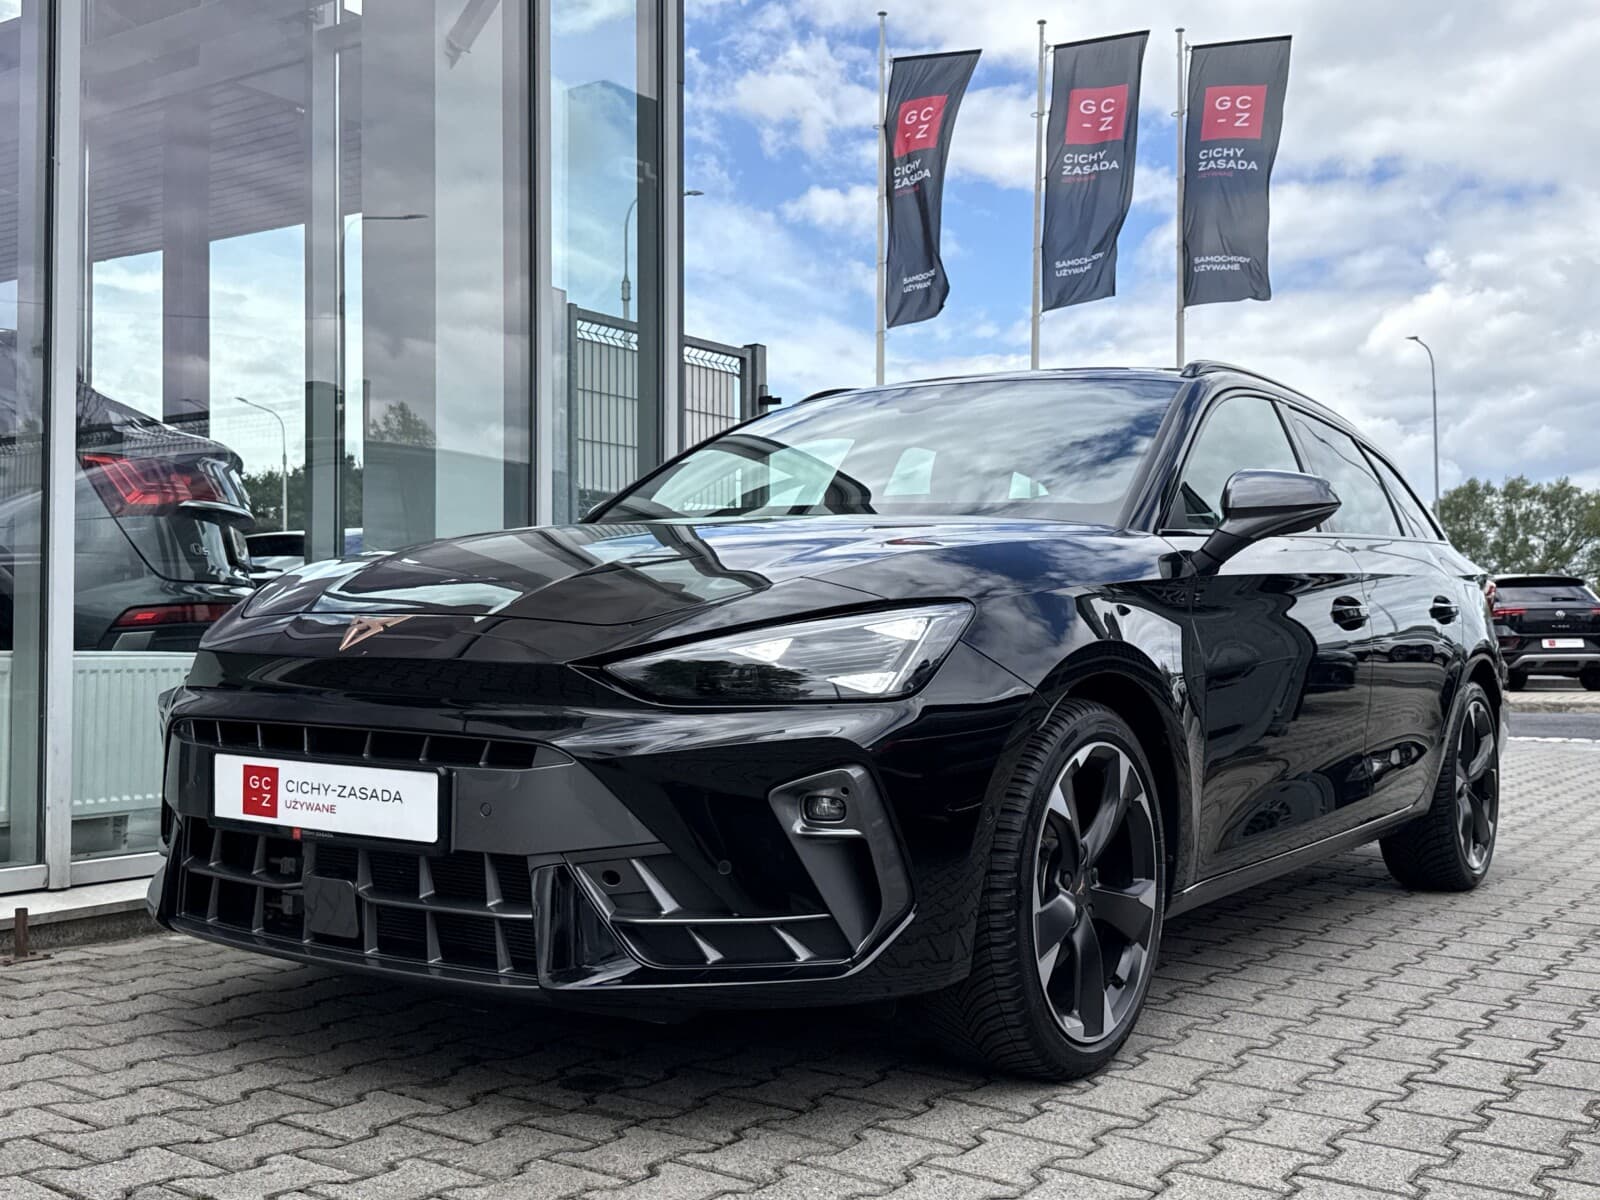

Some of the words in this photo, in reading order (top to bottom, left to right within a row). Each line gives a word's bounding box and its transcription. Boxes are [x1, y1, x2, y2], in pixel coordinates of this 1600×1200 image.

[1080, 98, 1115, 114] GC
[1215, 95, 1252, 110] GC
[905, 107, 934, 125] GC
[1063, 150, 1107, 164] CICHY
[1199, 147, 1245, 159] CICHY
[1062, 160, 1119, 175] ZASADA
[1198, 159, 1258, 171] ZASADA
[249, 775, 272, 790] GC
[285, 779, 404, 804] CICHY-ZASADA
[284, 798, 337, 814] UŻYWANE
